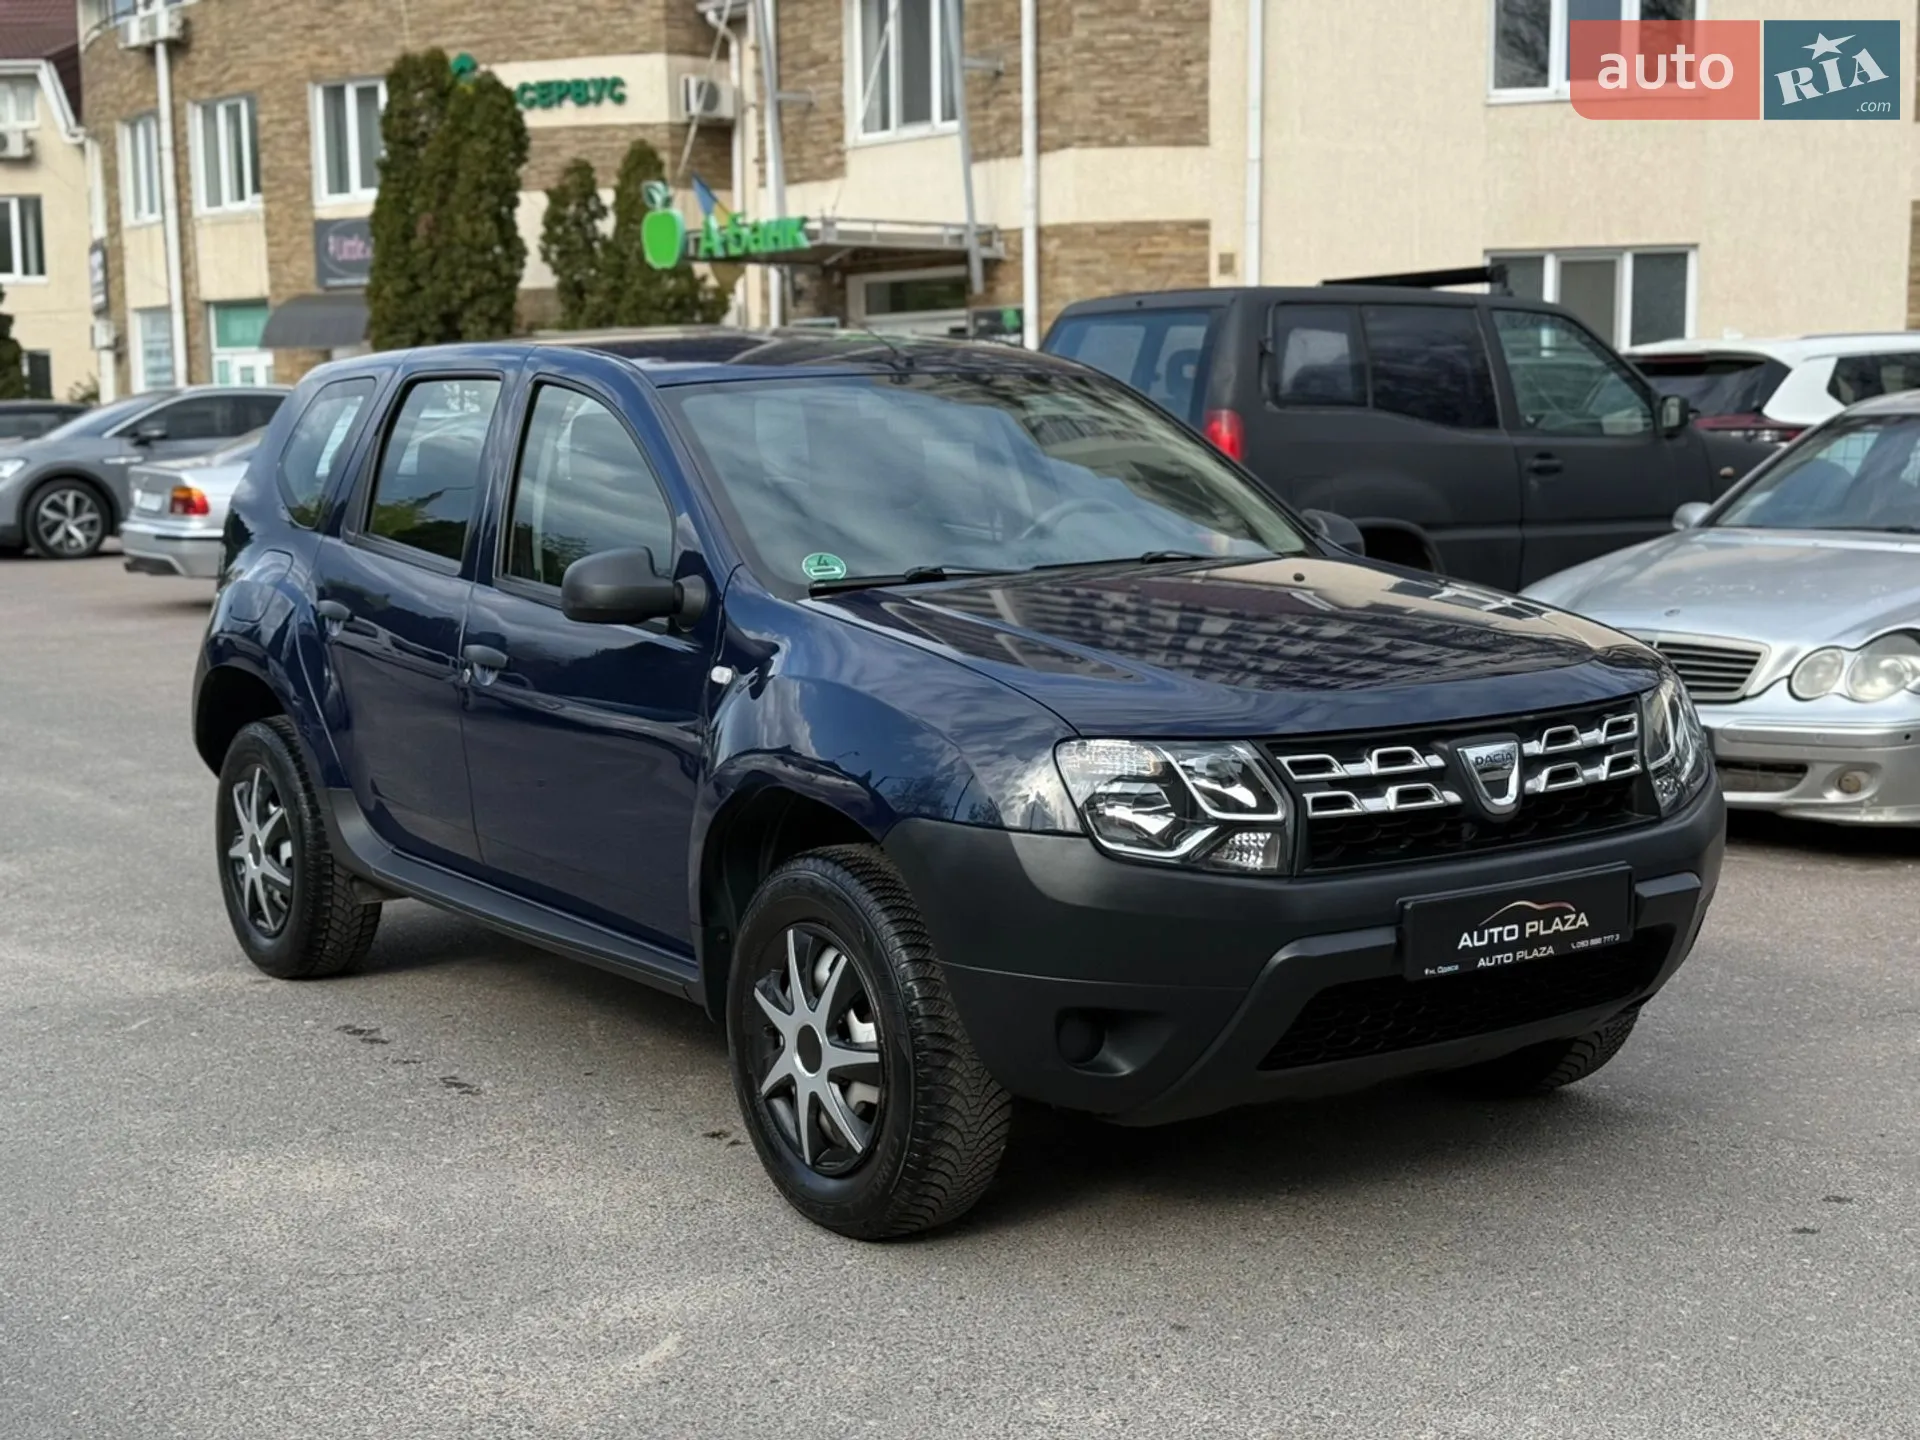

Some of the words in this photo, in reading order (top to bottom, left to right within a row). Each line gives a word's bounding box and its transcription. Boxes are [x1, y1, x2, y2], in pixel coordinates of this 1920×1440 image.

[515, 76, 627, 110] СЕРВУС
[1474, 752, 1513, 766] DACIA
[1457, 924, 1519, 950] AUTO
[1525, 912, 1590, 938] PLAZA
[1477, 953, 1513, 968] AUTO
[1516, 945, 1555, 961] PLAZA
